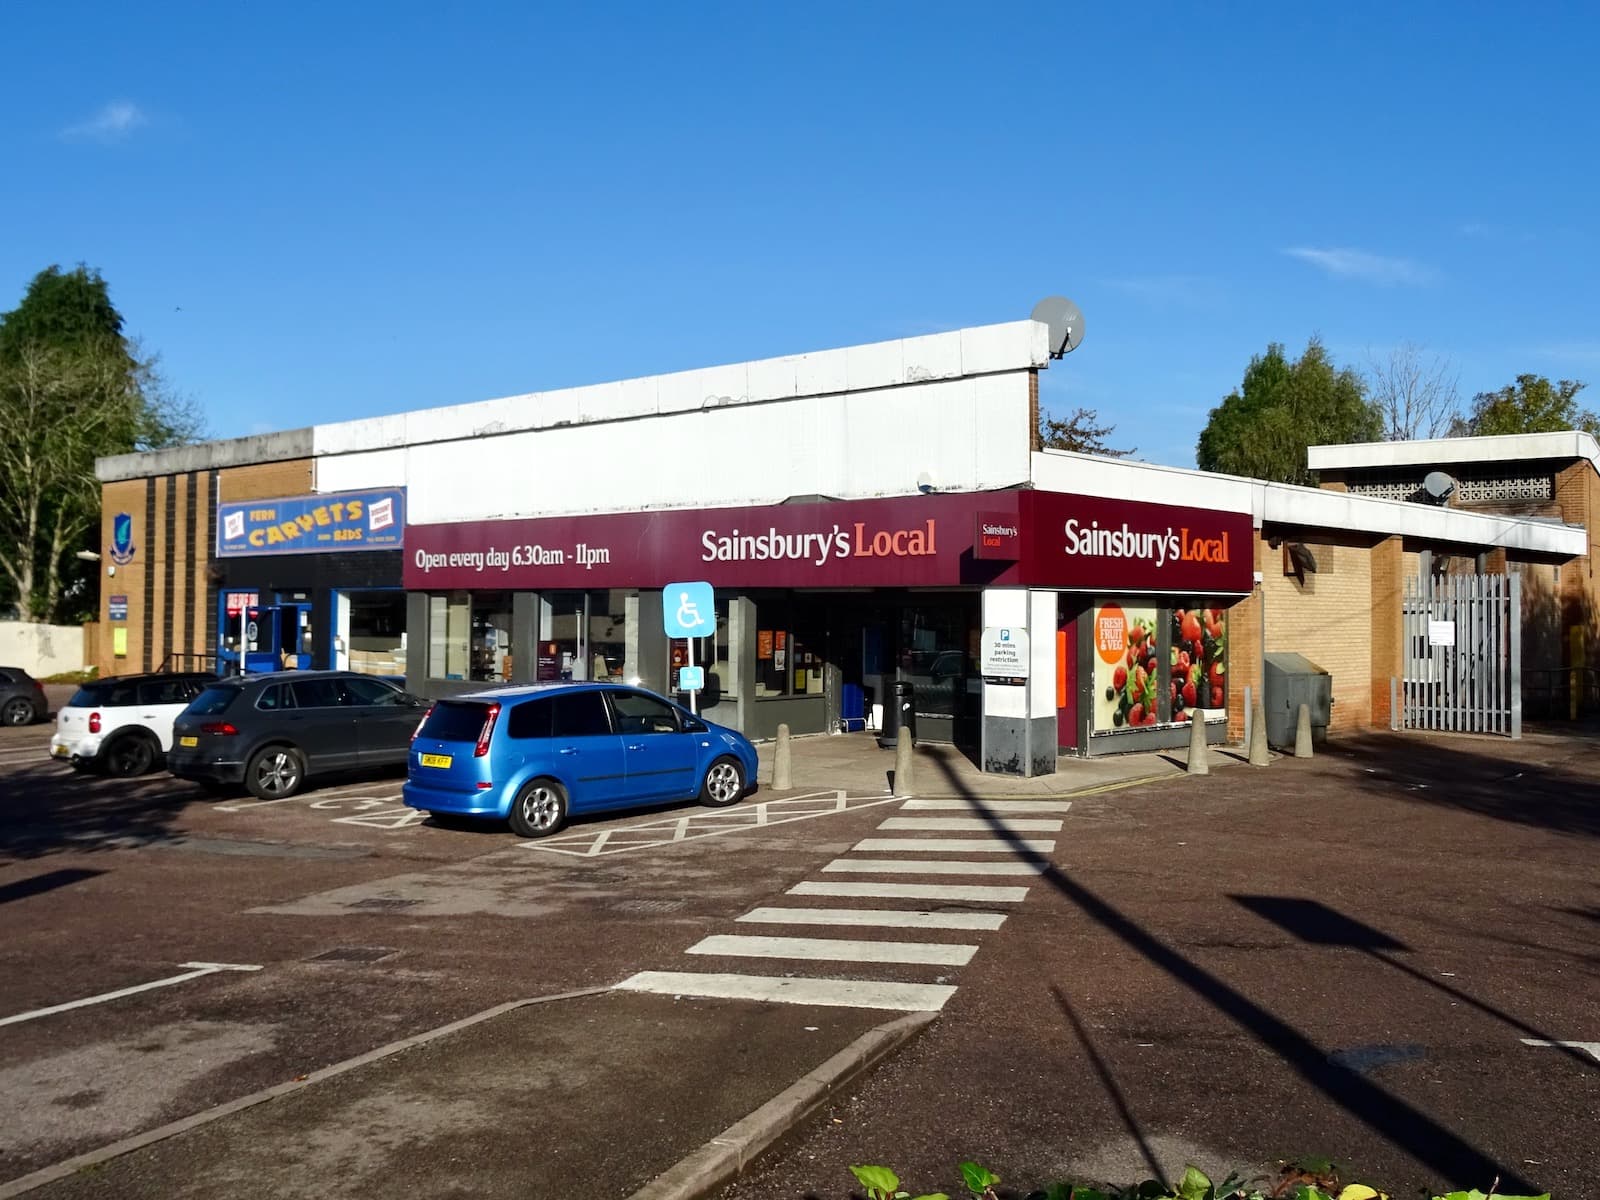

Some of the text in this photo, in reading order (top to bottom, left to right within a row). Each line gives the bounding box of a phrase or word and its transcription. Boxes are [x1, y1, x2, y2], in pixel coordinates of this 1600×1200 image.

[248, 500, 363, 547] CARPETS
[982, 524, 1018, 538] Sainsbury's
[702, 519, 937, 566] Sainsbury's Local
[983, 535, 1001, 547] Local
[1065, 518, 1230, 567] Sainsbury's Local
[415, 549, 448, 573] Open
[449, 551, 484, 572] every
[486, 546, 510, 572] day
[512, 544, 564, 566] 6.30am
[575, 543, 610, 570] 11pm
[1100, 617, 1123, 629] FRESH
[1100, 628, 1122, 640] FRUIT
[1101, 639, 1123, 651] & VEG
[994, 649, 1016, 657] parking
